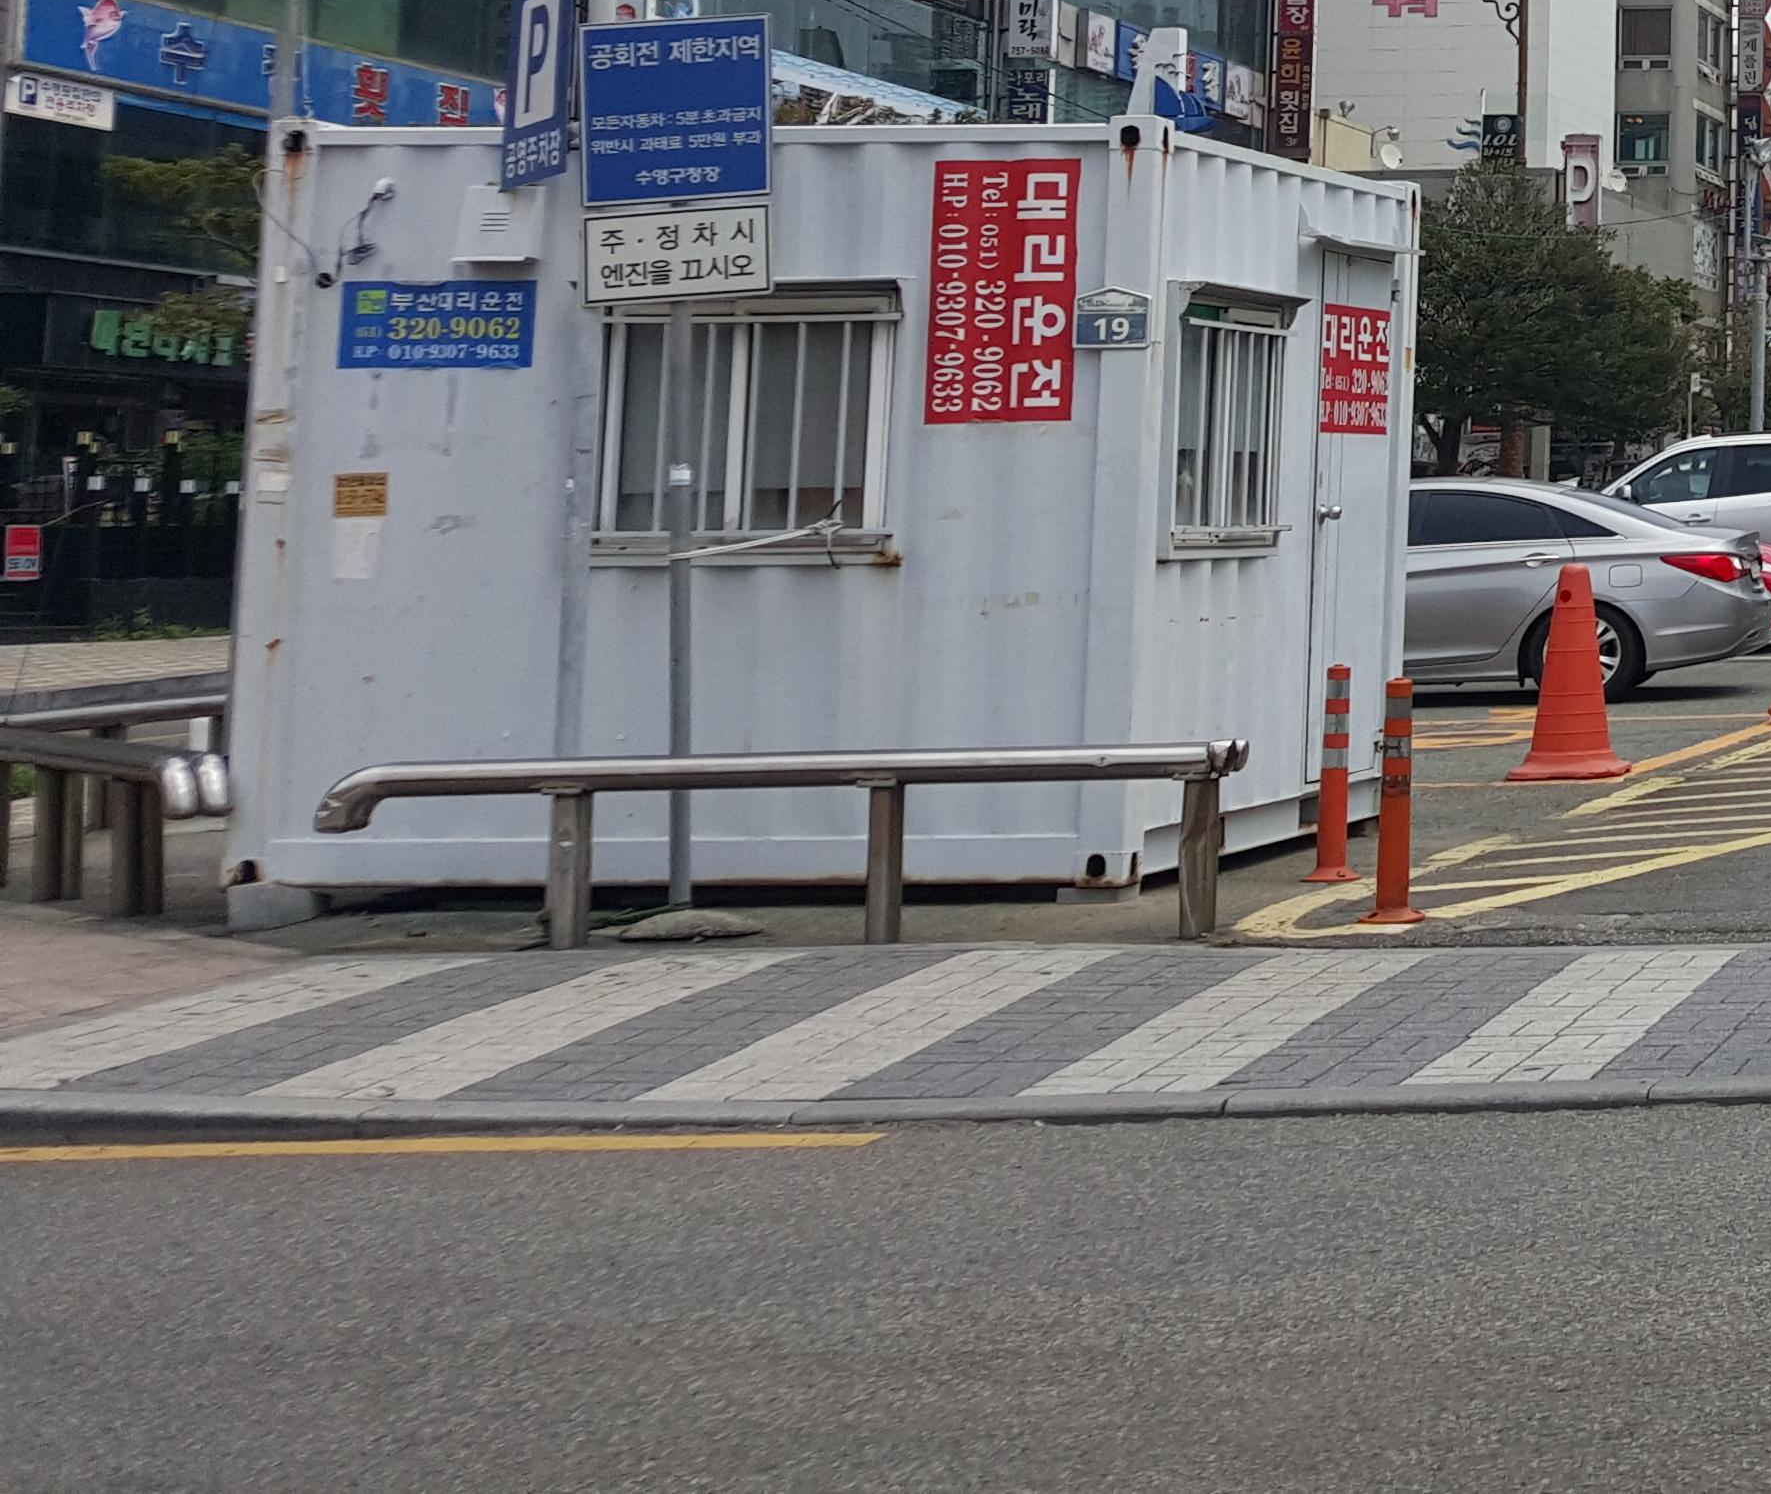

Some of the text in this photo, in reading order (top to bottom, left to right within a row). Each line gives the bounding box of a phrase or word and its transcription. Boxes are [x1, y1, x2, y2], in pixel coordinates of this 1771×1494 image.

[523, 2, 550, 114] P
[587, 34, 762, 70] 공회전 제한지역
[673, 107, 762, 127] 5분 초과금지
[1011, 86, 1043, 119] 노래
[504, 126, 563, 181] 공영주차장
[590, 129, 762, 156] 위반시 과태료 5만원 부과
[634, 165, 721, 187] 수영구청장
[1566, 155, 1598, 227] P
[600, 255, 756, 291] 엔진을 끄시오
[389, 291, 524, 313] 부산대리운전
[1009, 171, 1070, 410] 대리운전
[387, 316, 522, 340] 320-9062
[1095, 317, 1132, 342] 19
[1322, 313, 1391, 363] 대리운전
[386, 343, 521, 361] 010-9307-9633
